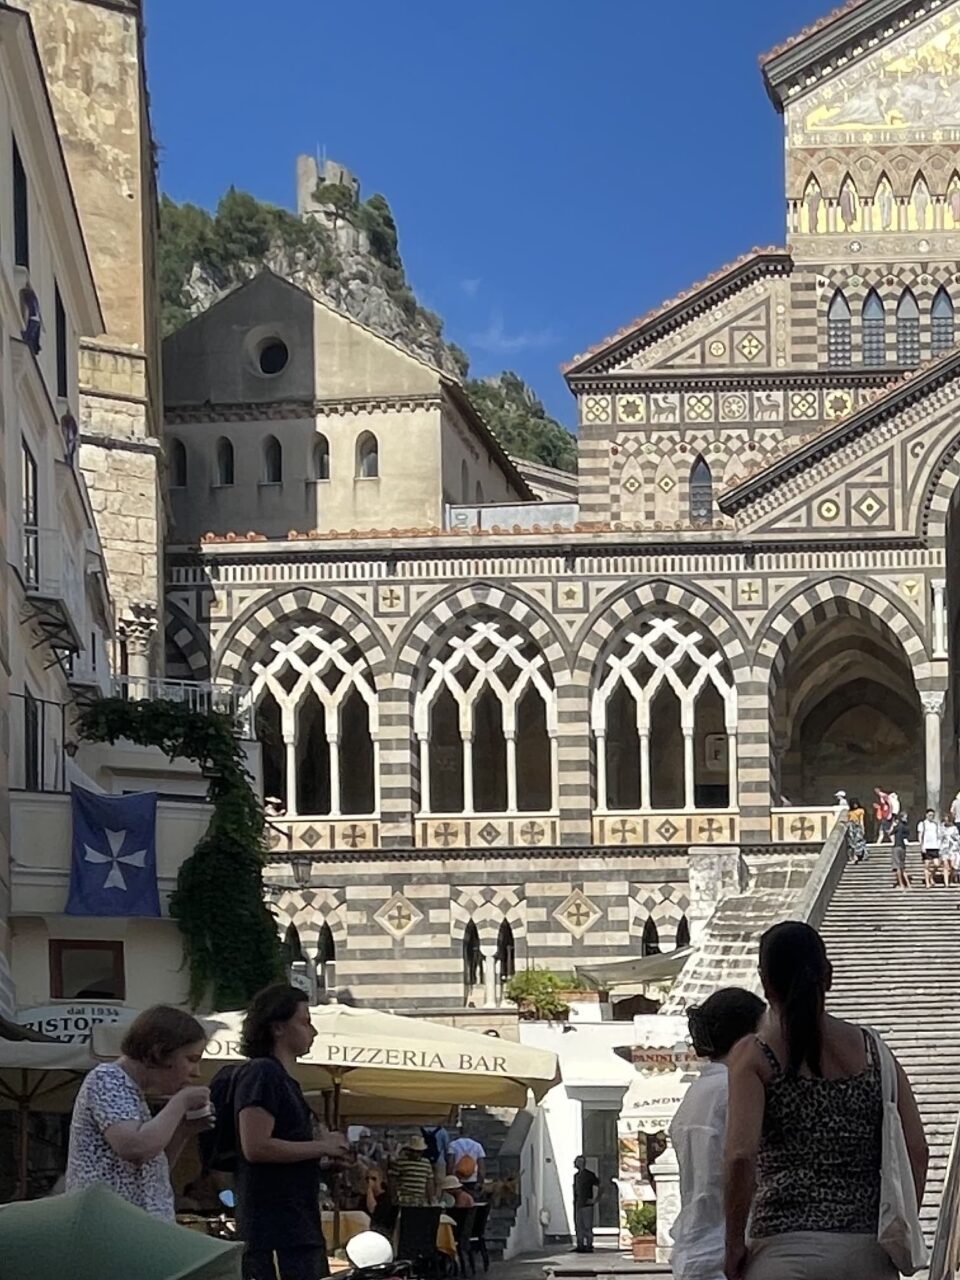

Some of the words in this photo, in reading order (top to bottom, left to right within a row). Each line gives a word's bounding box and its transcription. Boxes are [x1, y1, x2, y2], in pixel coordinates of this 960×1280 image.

[67, 1007, 86, 1015] dal
[327, 1045, 445, 1068] PIZZERIA
[459, 1054, 508, 1072] BAR
[633, 1097, 682, 1109] SANDW
